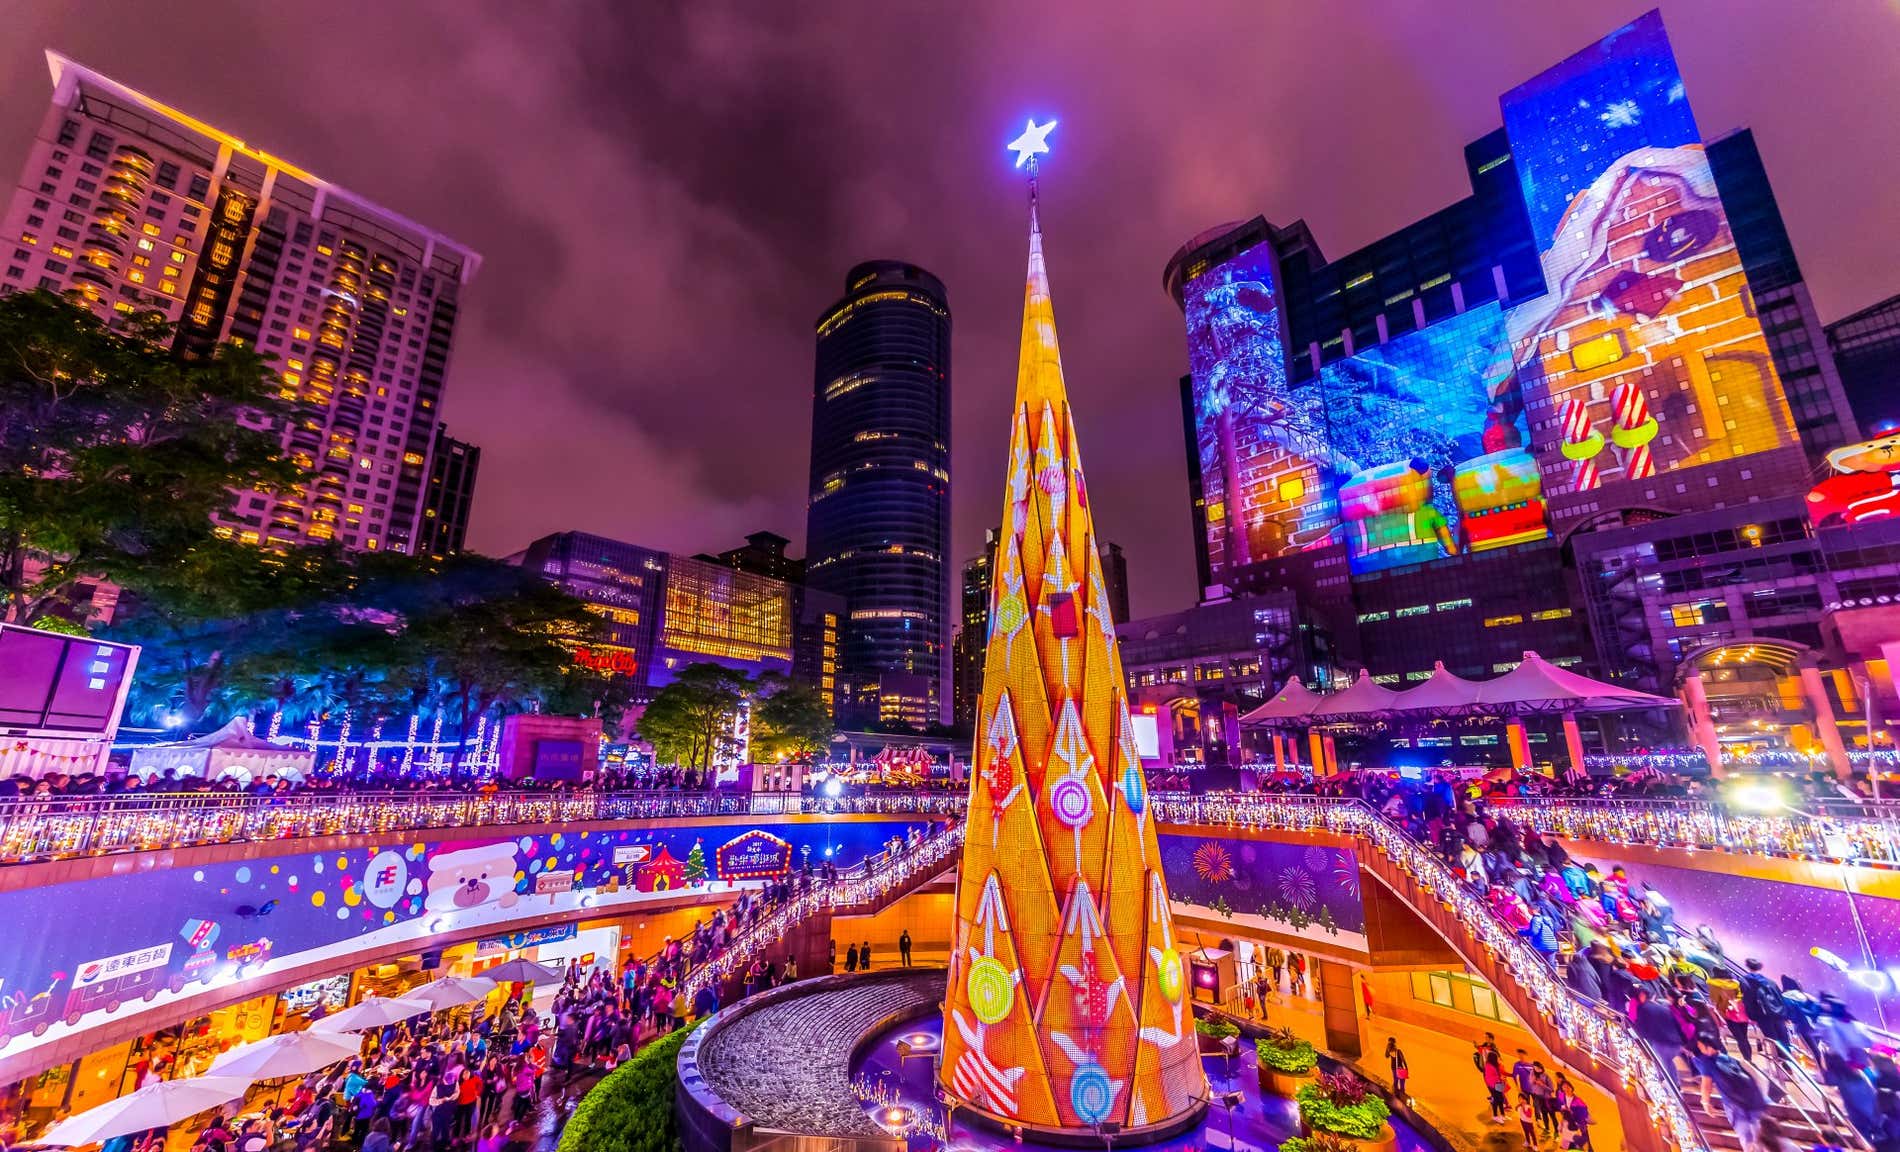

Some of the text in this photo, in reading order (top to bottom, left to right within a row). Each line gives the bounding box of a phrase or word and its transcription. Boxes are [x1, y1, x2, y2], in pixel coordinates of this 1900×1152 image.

[575, 646, 638, 676] Mega City
[104, 947, 168, 973] 遠東百貨
